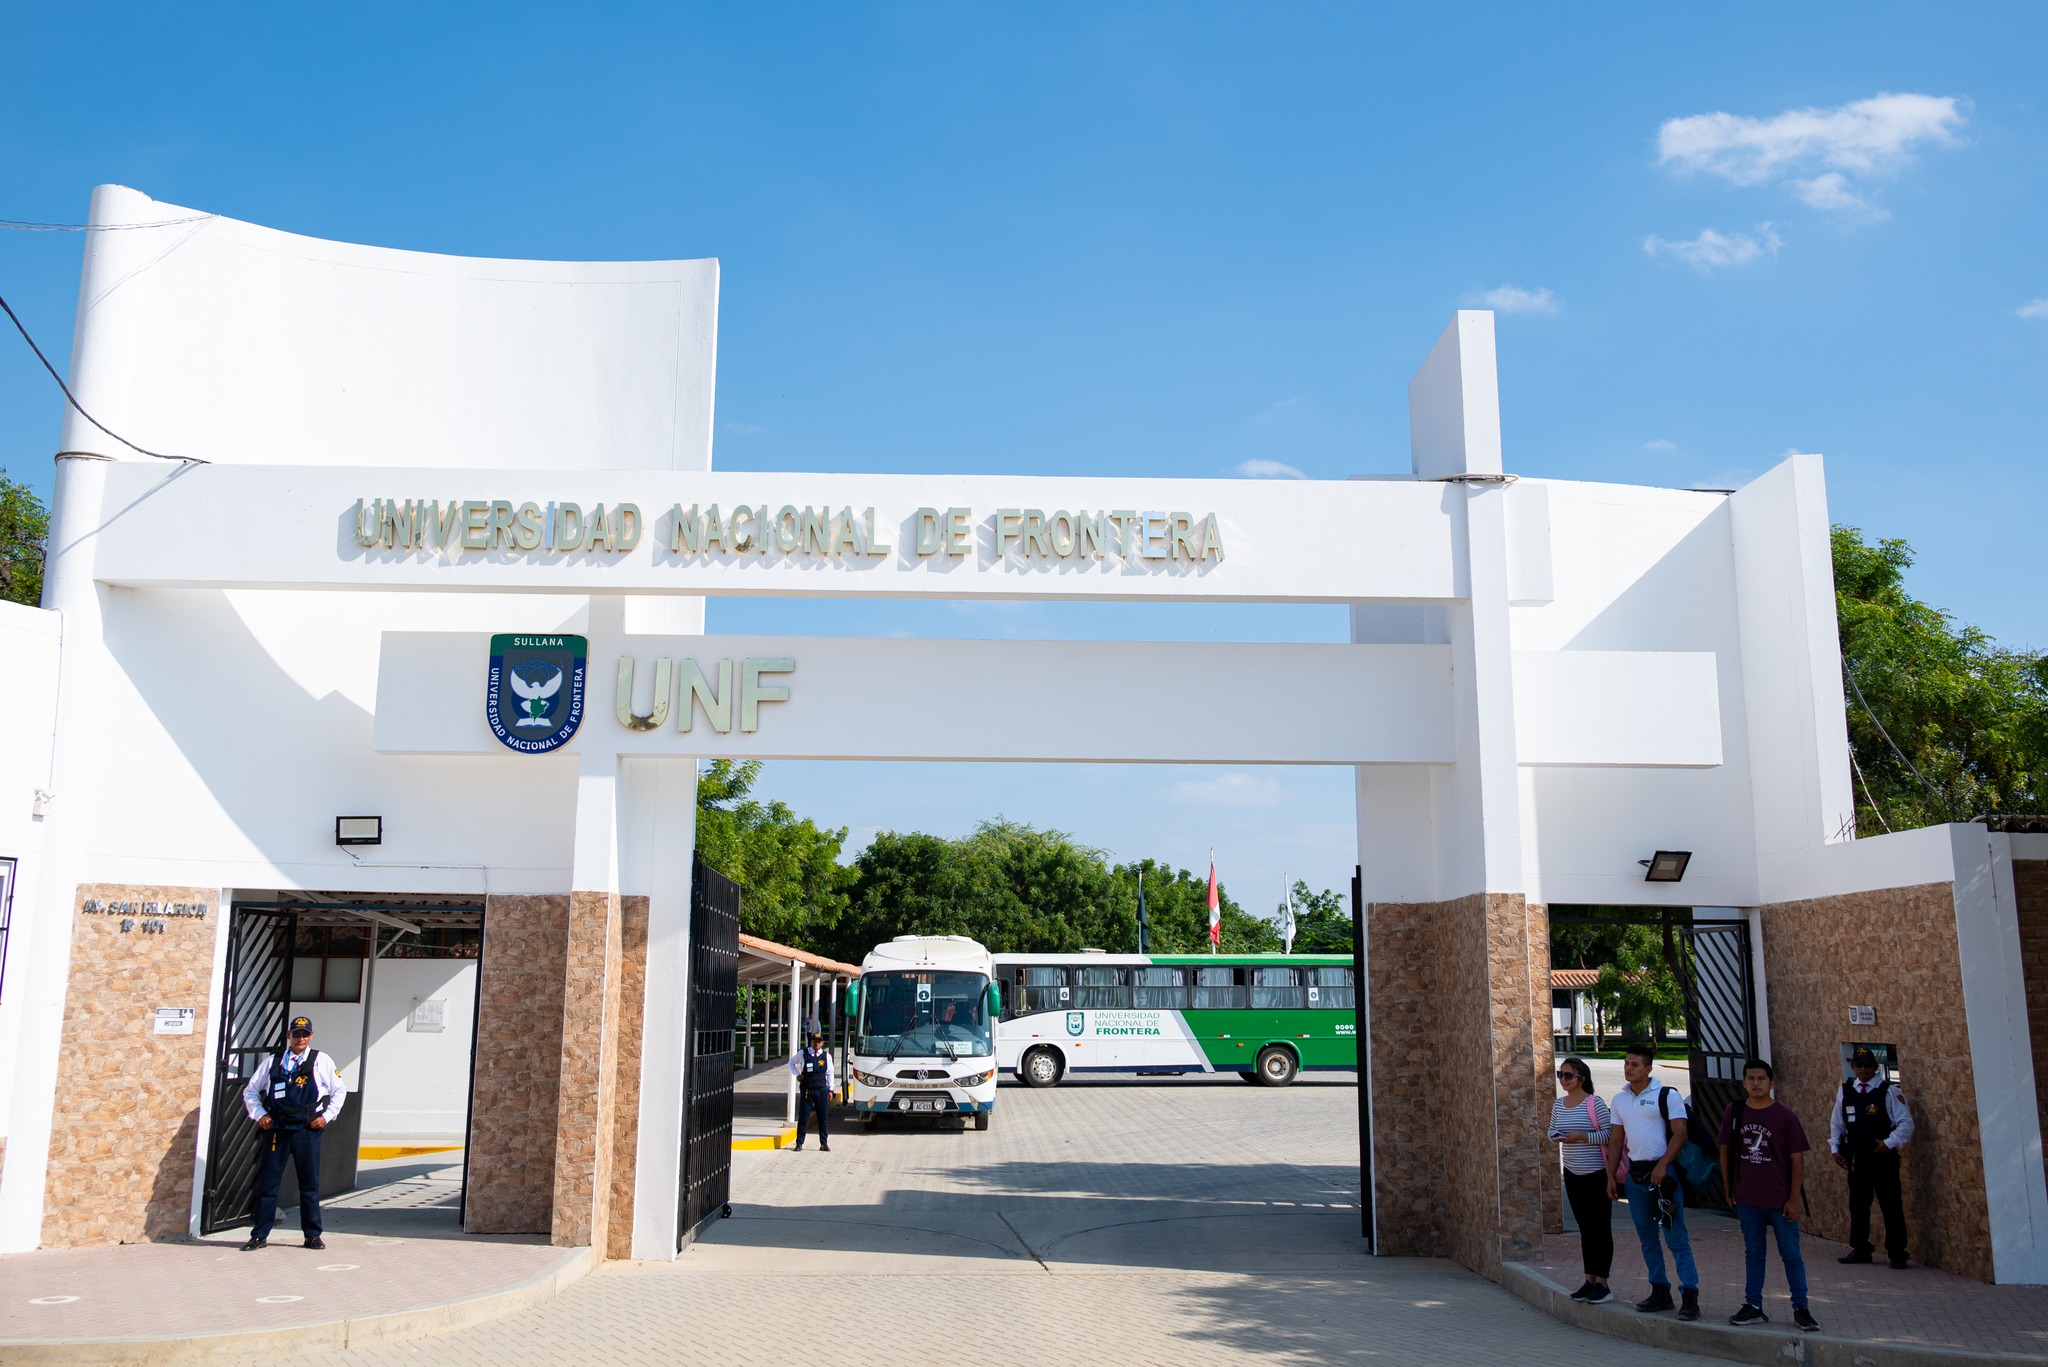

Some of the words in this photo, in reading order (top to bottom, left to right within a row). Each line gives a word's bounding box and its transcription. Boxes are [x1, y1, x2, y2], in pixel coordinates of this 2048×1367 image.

[357, 498, 643, 551] UNIVERSIDAD
[671, 503, 891, 557] NACIONAL
[916, 506, 972, 556] DE
[996, 508, 1227, 562] FRONTERA
[513, 637, 564, 646] SULLANA
[488, 667, 506, 737] UNIVERSIDAD
[506, 735, 559, 750] NACIONAL
[559, 725, 573, 739] DE
[569, 668, 583, 723] FRONTERA
[616, 655, 796, 734] UNF
[108, 900, 140, 915] SAN
[141, 901, 207, 917] HILARION
[142, 919, 167, 932] 101
